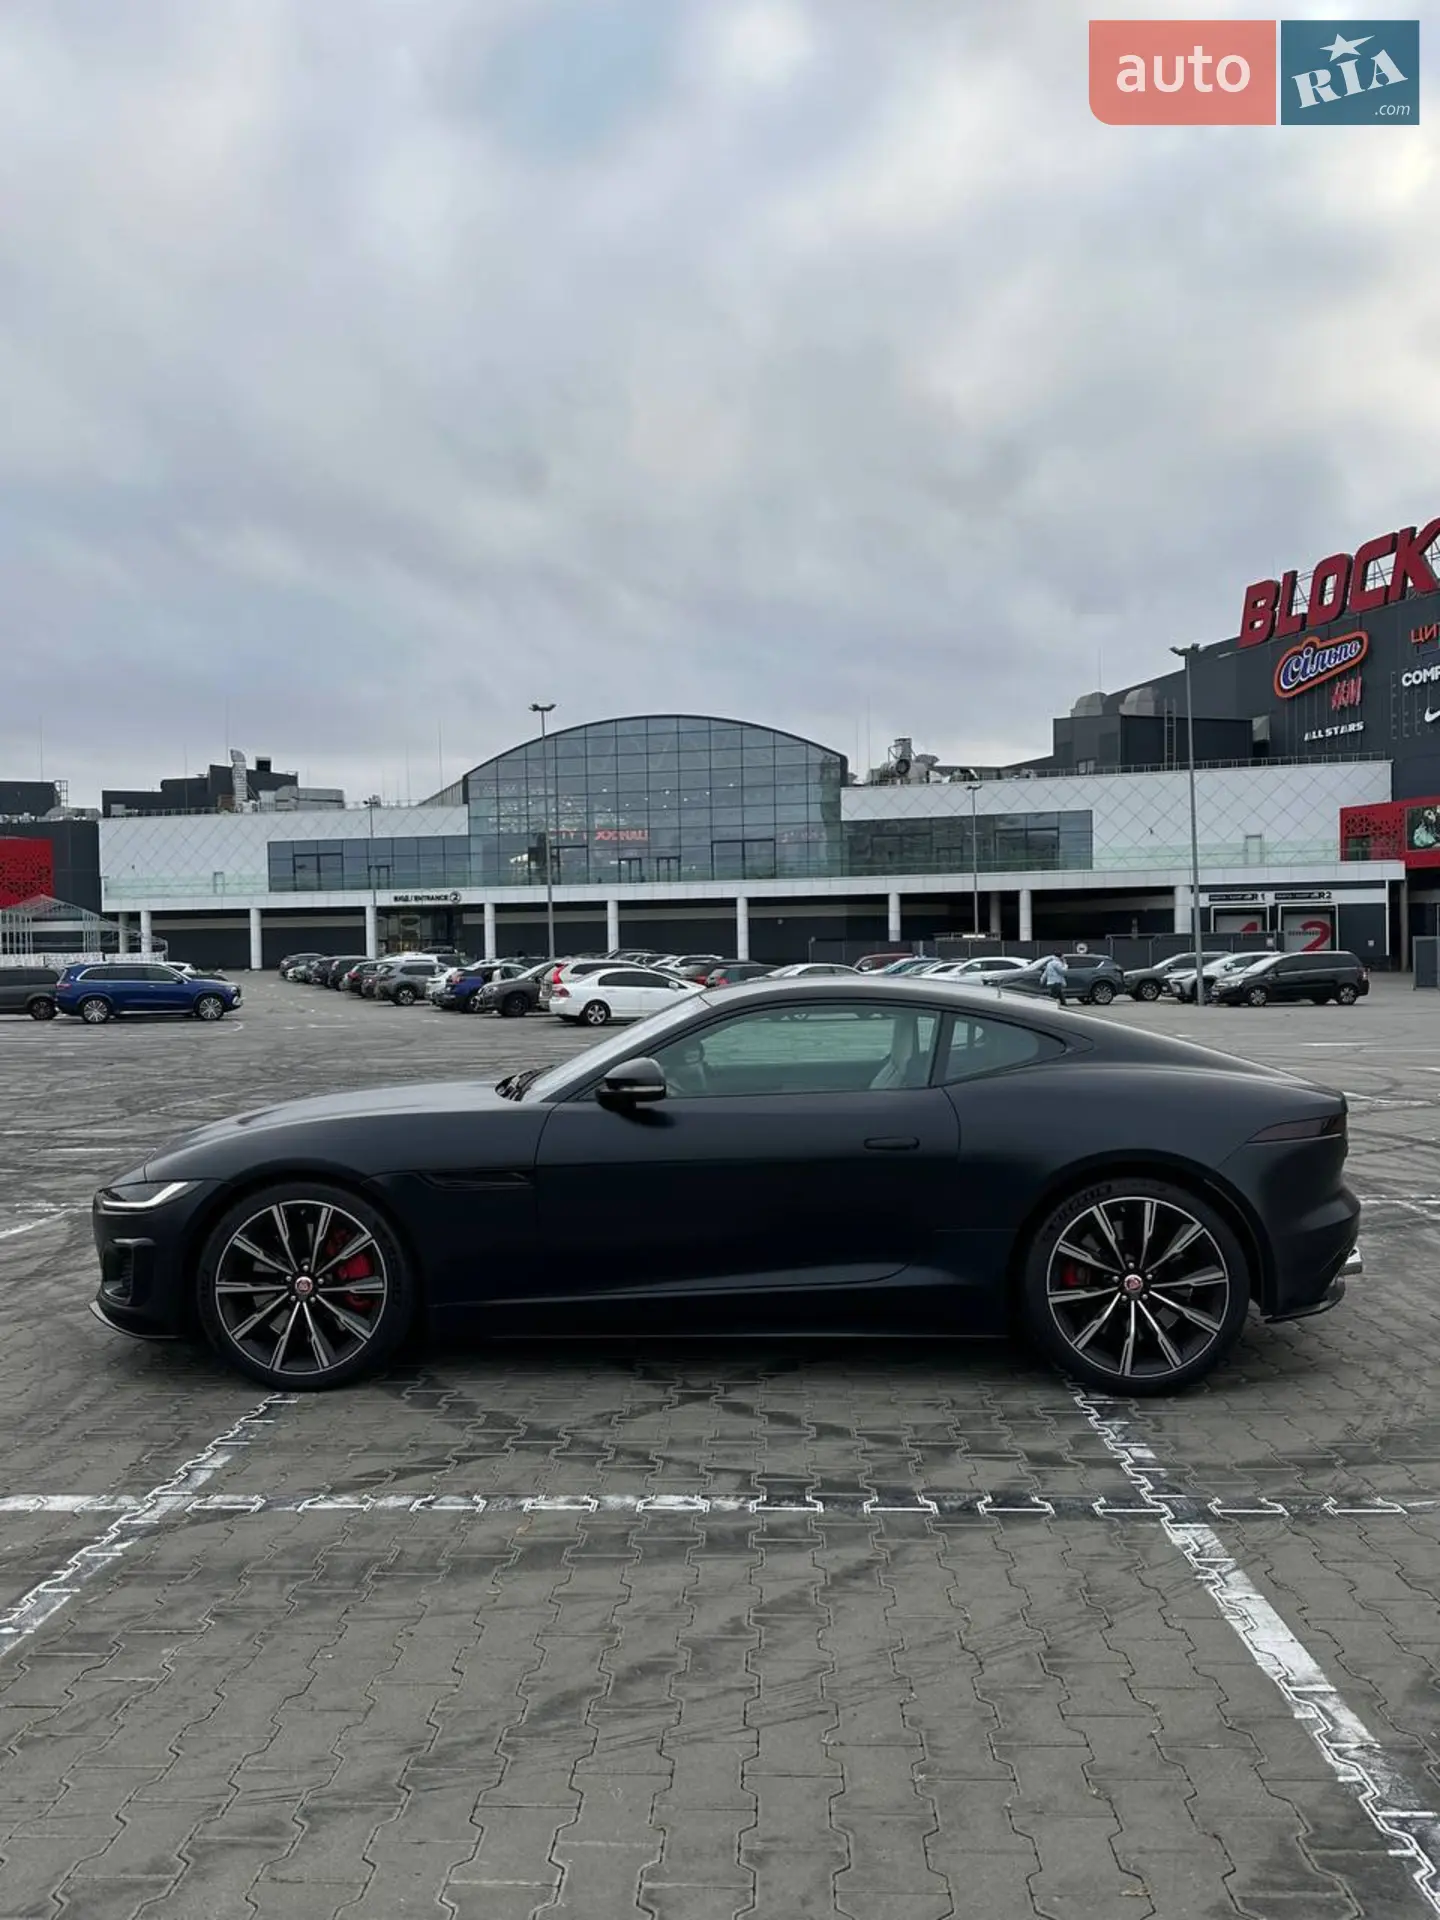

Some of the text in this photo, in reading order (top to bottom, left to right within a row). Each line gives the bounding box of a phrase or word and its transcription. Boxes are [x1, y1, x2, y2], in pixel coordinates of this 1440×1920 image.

[1238, 516, 1440, 649] BLOCK
[1409, 622, 1440, 643] ЦИ
[1280, 639, 1361, 690] Сільпо
